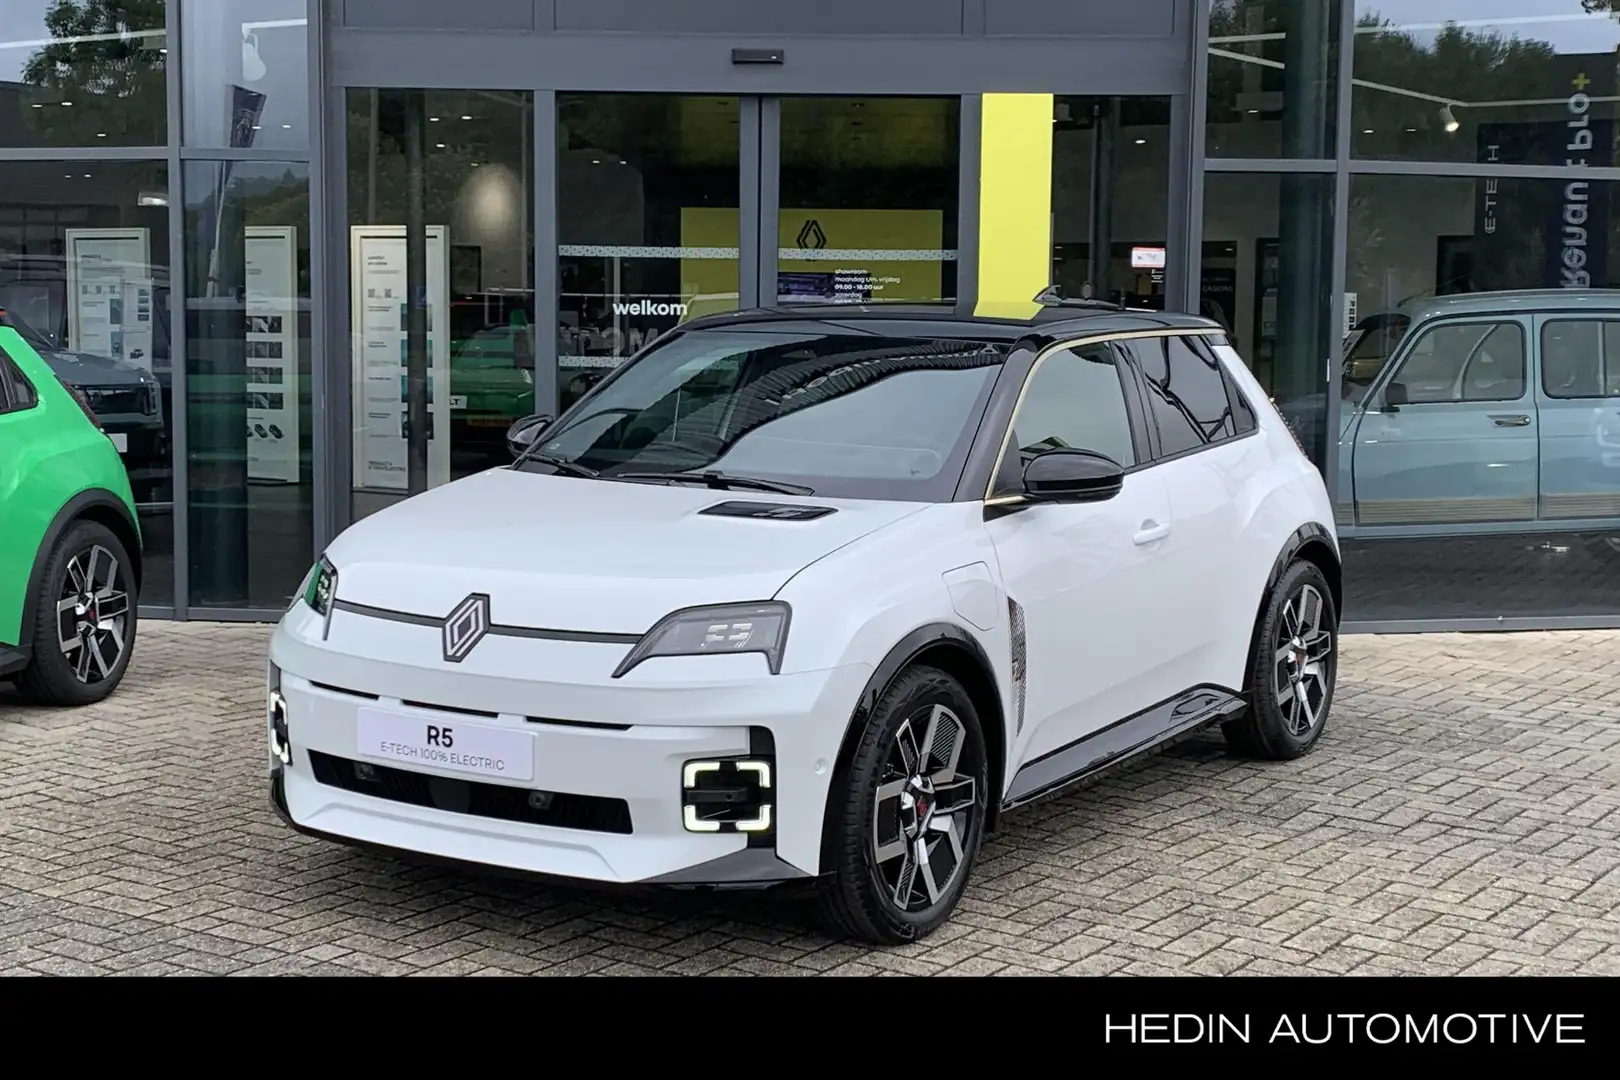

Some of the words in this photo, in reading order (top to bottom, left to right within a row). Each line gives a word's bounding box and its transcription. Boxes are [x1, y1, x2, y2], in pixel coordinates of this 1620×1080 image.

[878, 276, 901, 284] vrijdag
[612, 300, 688, 316] welkom
[426, 725, 454, 748] R5
[380, 741, 418, 757] E-TECH
[420, 748, 448, 762] 100%
[450, 754, 505, 771] ELECTRIC
